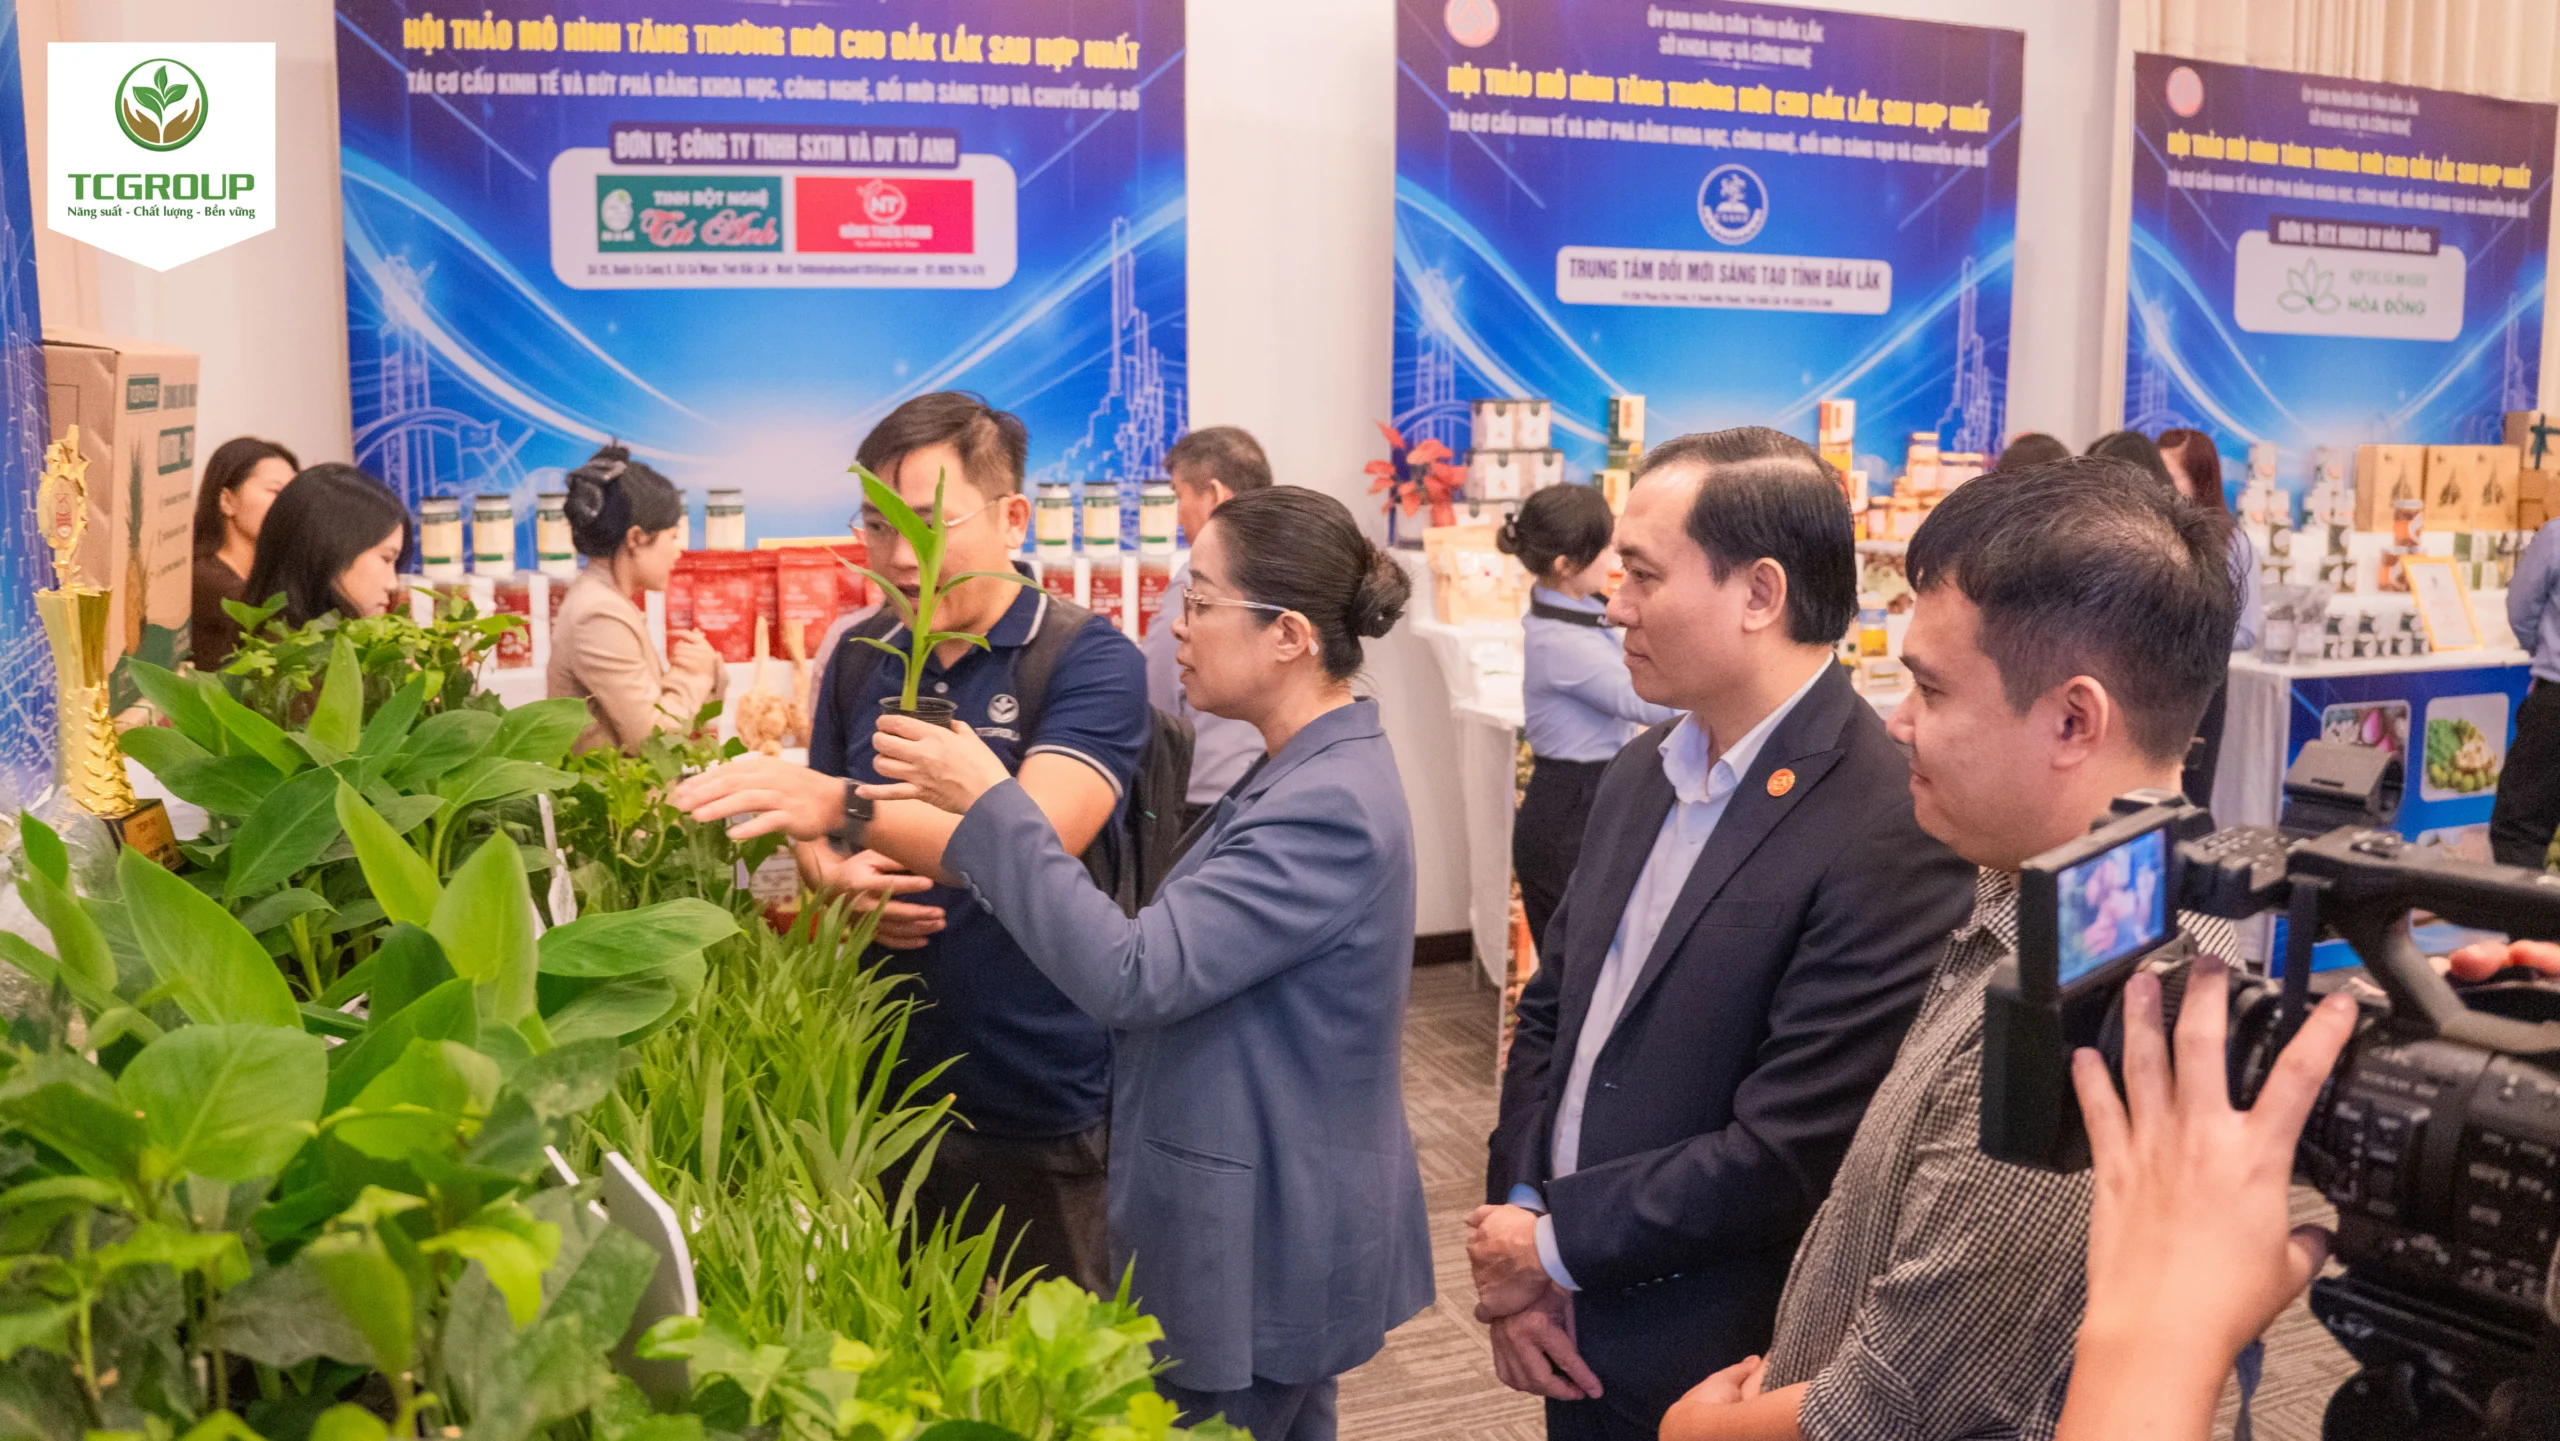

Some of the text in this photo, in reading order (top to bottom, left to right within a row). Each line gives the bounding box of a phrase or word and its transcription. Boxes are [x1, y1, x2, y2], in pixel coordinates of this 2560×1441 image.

[403, 12, 1140, 73] HỘI THẢO MÔ HÌNH TĂNG TRƯỞNG MỚI CHO ĐẮK LẮK SAU HỢP NHẤT
[407, 68, 432, 94] TÁI
[436, 70, 459, 95] CƠ
[500, 72, 537, 95] KINH
[540, 68, 560, 96] TẾ
[562, 70, 584, 96] VÀ
[701, 76, 743, 98] KHOA
[784, 75, 826, 100] CÔNG
[1484, 62, 1532, 98] THẢO
[615, 129, 656, 159] ĐƠN
[680, 127, 726, 160] CÔNG
[729, 132, 751, 160] TY
[754, 132, 796, 161] TNHH
[800, 133, 846, 161] SXTM
[848, 131, 872, 162] VÀ
[874, 135, 896, 163] DV
[921, 137, 955, 164] ANH
[1569, 257, 1618, 280] TRUNG
[1623, 256, 1653, 281] TÂM
[1659, 252, 1682, 282] ĐỔI
[1688, 259, 1714, 283] MỚI
[1719, 258, 1757, 285] SÁNG
[1761, 264, 1787, 290] TẠO
